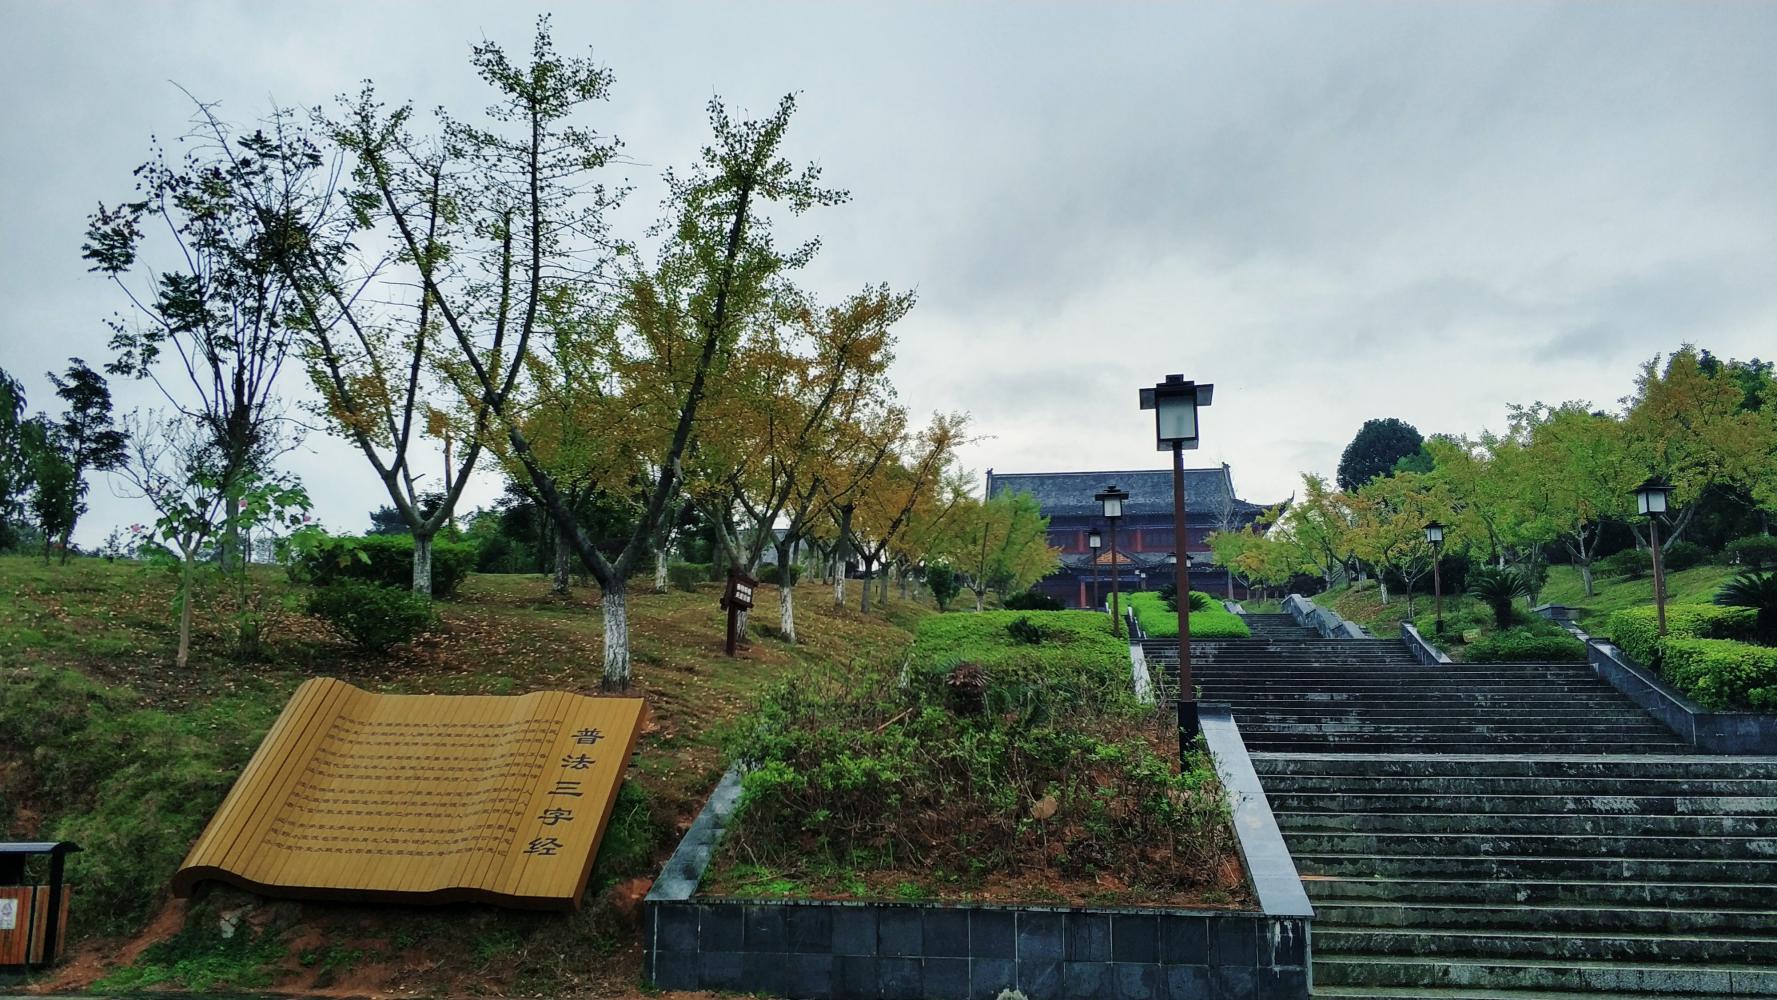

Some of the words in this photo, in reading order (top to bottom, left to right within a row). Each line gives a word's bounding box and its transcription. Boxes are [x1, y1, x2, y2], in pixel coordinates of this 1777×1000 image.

[524, 728, 605, 856] 普法三字经
